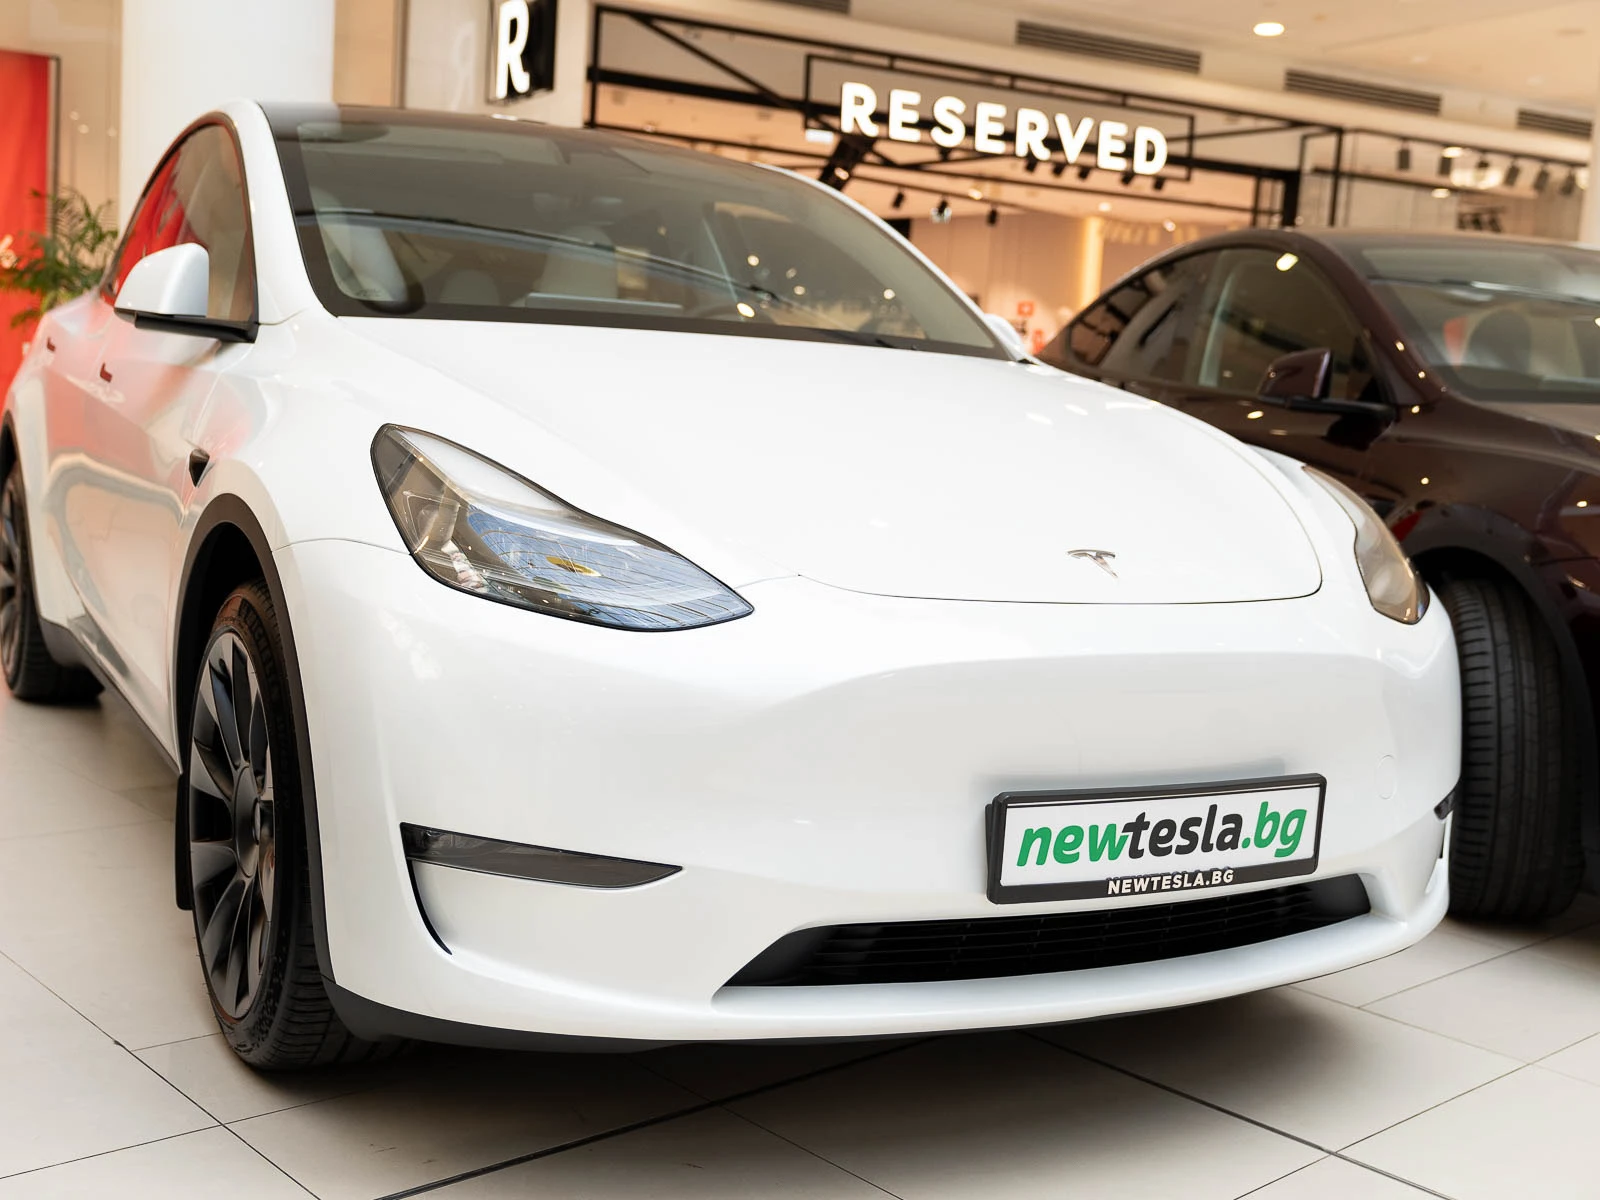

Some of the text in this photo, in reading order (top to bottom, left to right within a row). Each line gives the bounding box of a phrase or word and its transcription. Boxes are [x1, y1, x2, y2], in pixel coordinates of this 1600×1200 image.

[496, 0, 530, 99] R
[841, 82, 1168, 175] RESERVED
[1016, 801, 1307, 867] newtesla.bg
[1107, 870, 1234, 895] NEWTESLA.BG
